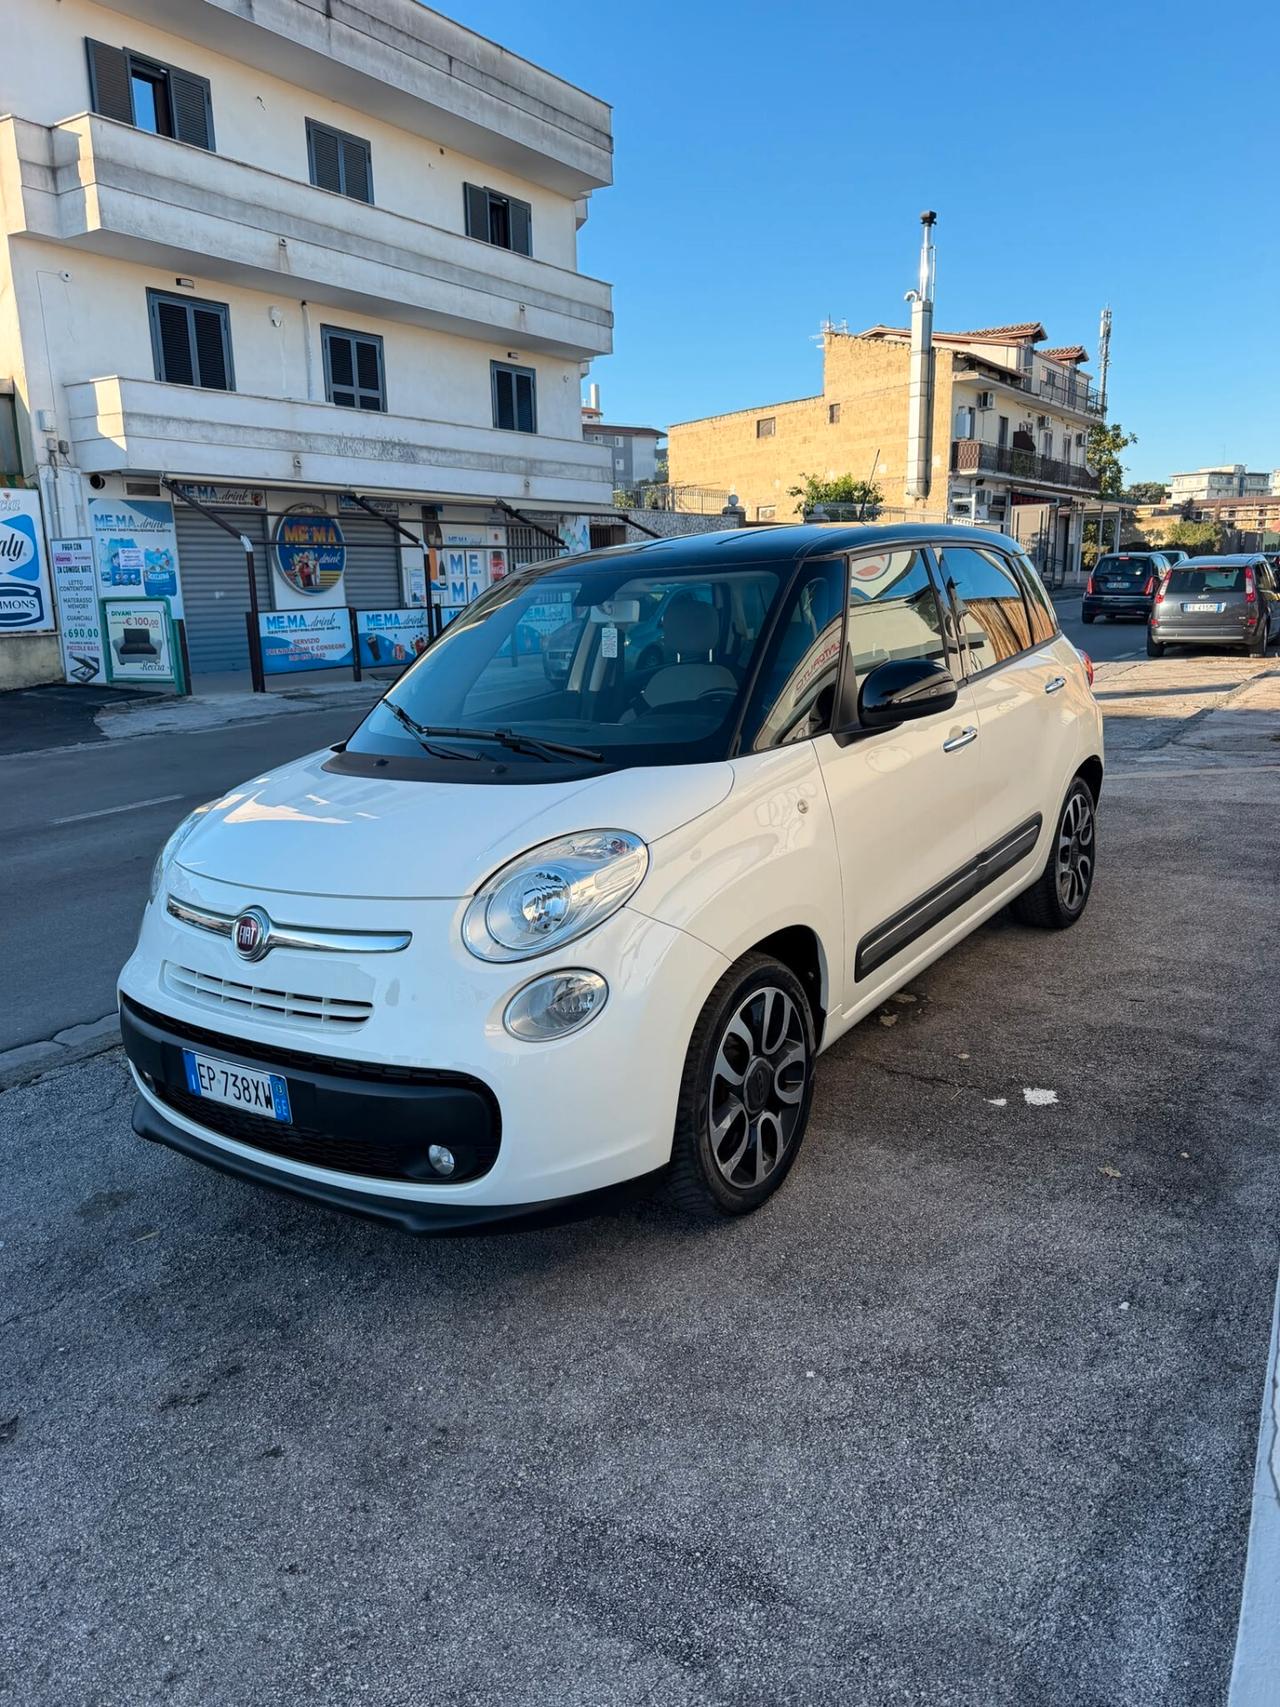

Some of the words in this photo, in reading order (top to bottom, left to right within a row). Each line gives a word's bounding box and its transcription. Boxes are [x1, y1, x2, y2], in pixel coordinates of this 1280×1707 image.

[0, 599, 36, 610] MONS
[238, 925, 256, 945] FIAT
[197, 1063, 216, 1092] EP
[220, 1070, 274, 1110] 738XW
